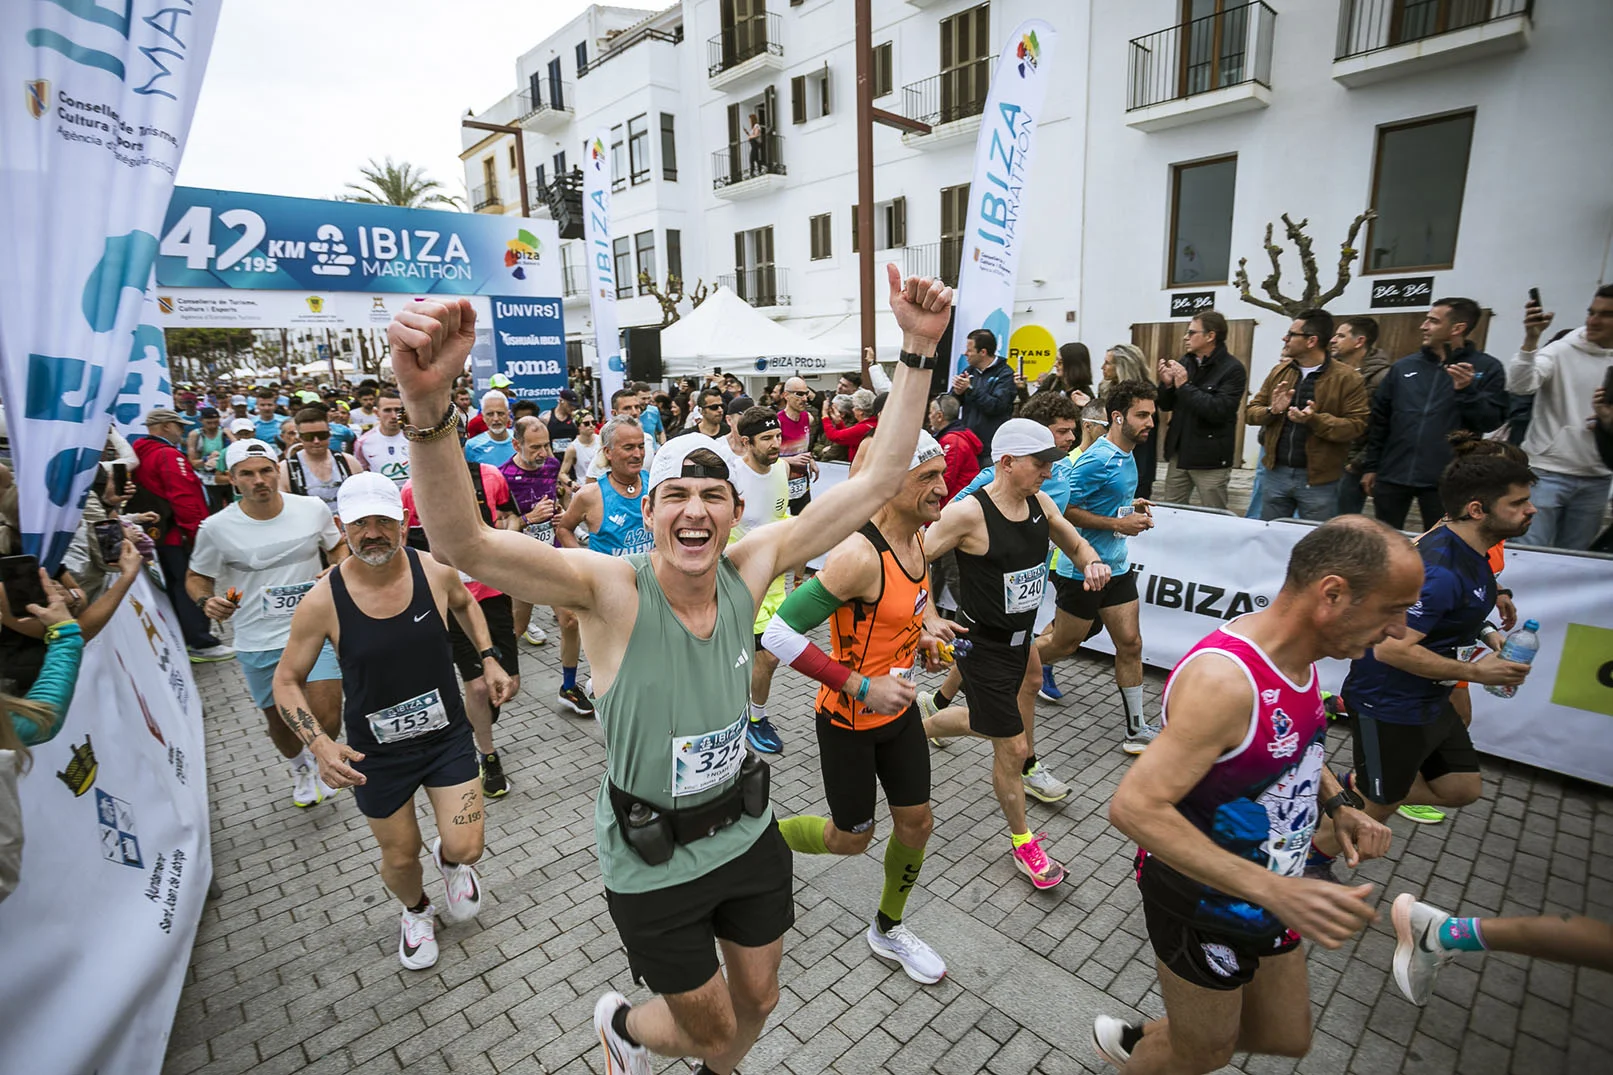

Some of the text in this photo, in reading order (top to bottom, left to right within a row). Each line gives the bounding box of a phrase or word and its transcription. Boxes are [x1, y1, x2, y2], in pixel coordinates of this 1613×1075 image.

[57, 106, 110, 132] Cultura
[978, 101, 1021, 246] IBIZA
[1004, 110, 1033, 256] MARATHON
[160, 205, 267, 271] 42
[268, 239, 306, 259] KM
[358, 226, 470, 263] IBIZA
[591, 188, 613, 284] IBIZA
[362, 259, 472, 280] MARATHON
[1372, 282, 1431, 299] Bla Bla
[769, 356, 826, 368] IBIZA PRO DJ
[1009, 348, 1051, 358] RYANS
[1018, 579, 1042, 600] 240
[390, 710, 430, 733] 153
[695, 735, 742, 773] 325
